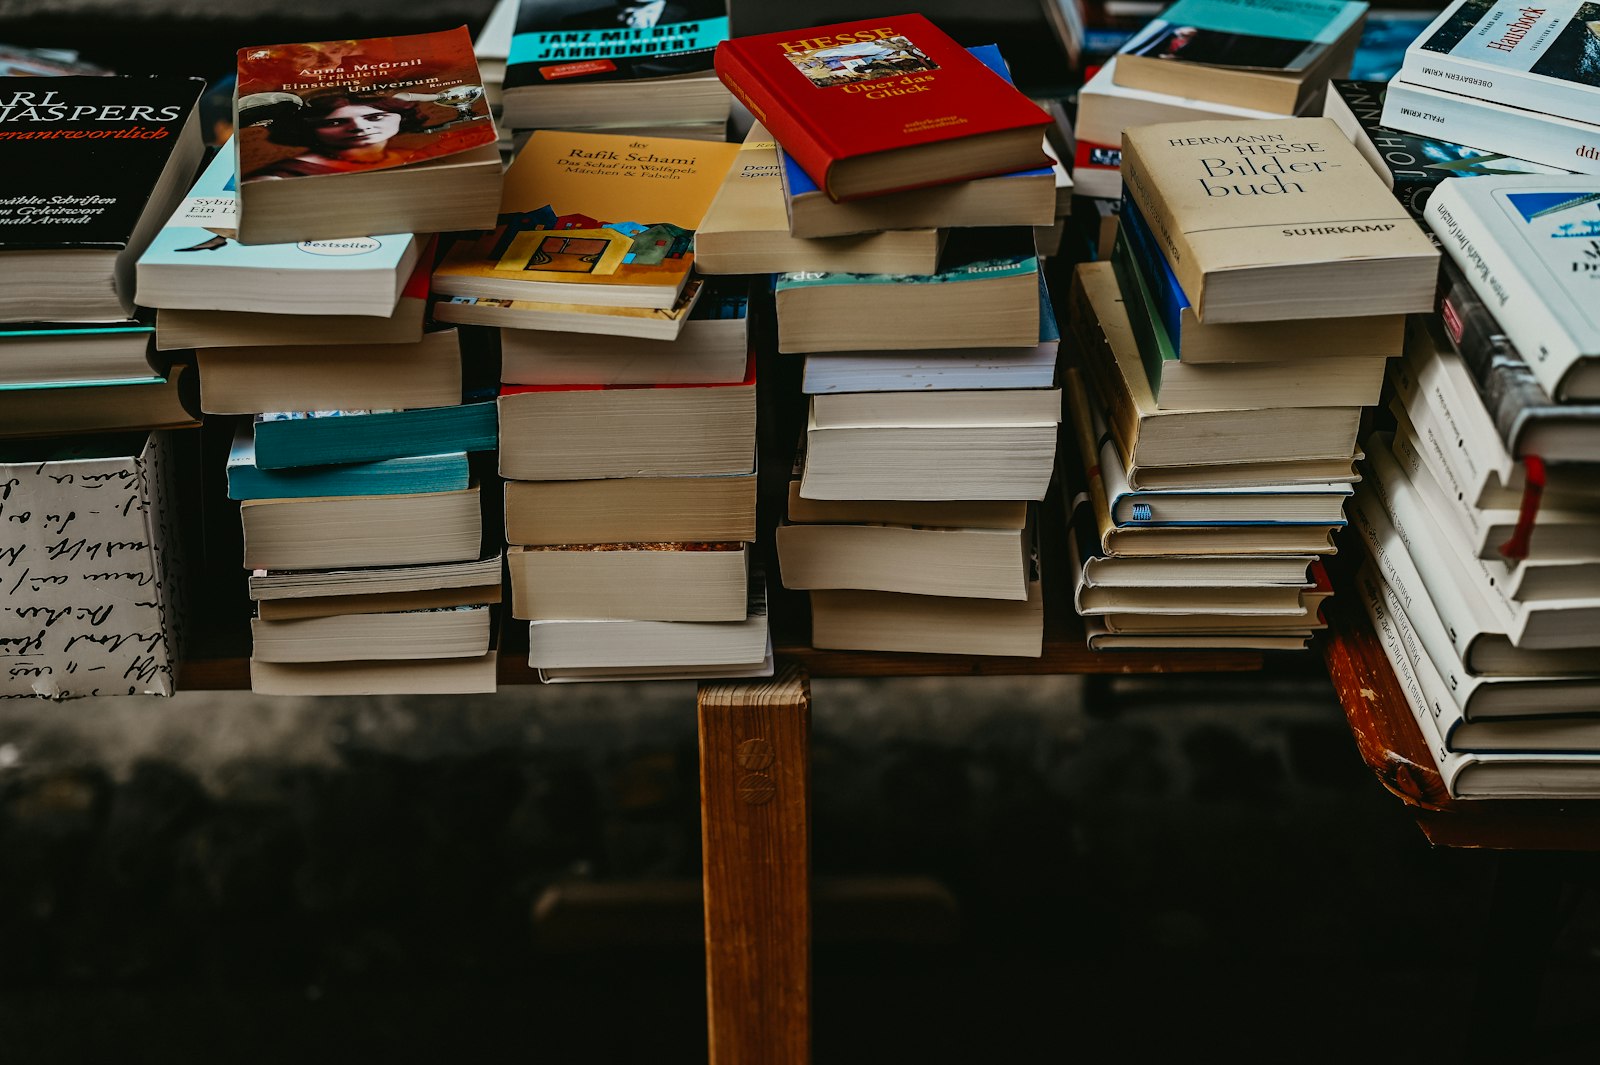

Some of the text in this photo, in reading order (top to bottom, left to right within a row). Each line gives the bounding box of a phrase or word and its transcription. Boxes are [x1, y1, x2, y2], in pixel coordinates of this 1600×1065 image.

[539, 24, 700, 44] TANZ MIT DEM
[1487, 7, 1546, 52] Hausbock
[777, 27, 901, 53] HESSE
[538, 38, 697, 59] JAHRHUNDERT
[300, 59, 422, 76] Anna McGrail
[319, 70, 388, 81] Fräulein
[282, 80, 361, 90] Einsteins
[348, 77, 463, 93] Universum Roman
[841, 74, 935, 94] Über das
[1422, 67, 1493, 88] OBERBAYERN KRIMI
[866, 84, 931, 100] Glück
[0, 105, 181, 123] JASPERS
[1400, 107, 1445, 124] PFALZ KRIMI
[1168, 134, 1283, 147] HERMANN
[1237, 142, 1325, 155] HESSE
[569, 149, 697, 165] Rafik Schami
[584, 161, 620, 169] Schaf
[641, 165, 697, 175] Wolfspelz
[1200, 155, 1342, 178] Bilder-
[641, 171, 680, 180] Fabeln
[1197, 175, 1307, 197] buch
[47, 195, 117, 206] Schriften
[194, 199, 236, 207] Sybil
[17, 206, 105, 215] Geleitwort
[189, 206, 216, 214] Ein
[31, 215, 92, 225] Arendt
[1282, 224, 1396, 237] SUHRKAMP
[303, 241, 376, 249] Bestseller
[967, 262, 1021, 274] Roman
[1411, 683, 1426, 718] Donna
